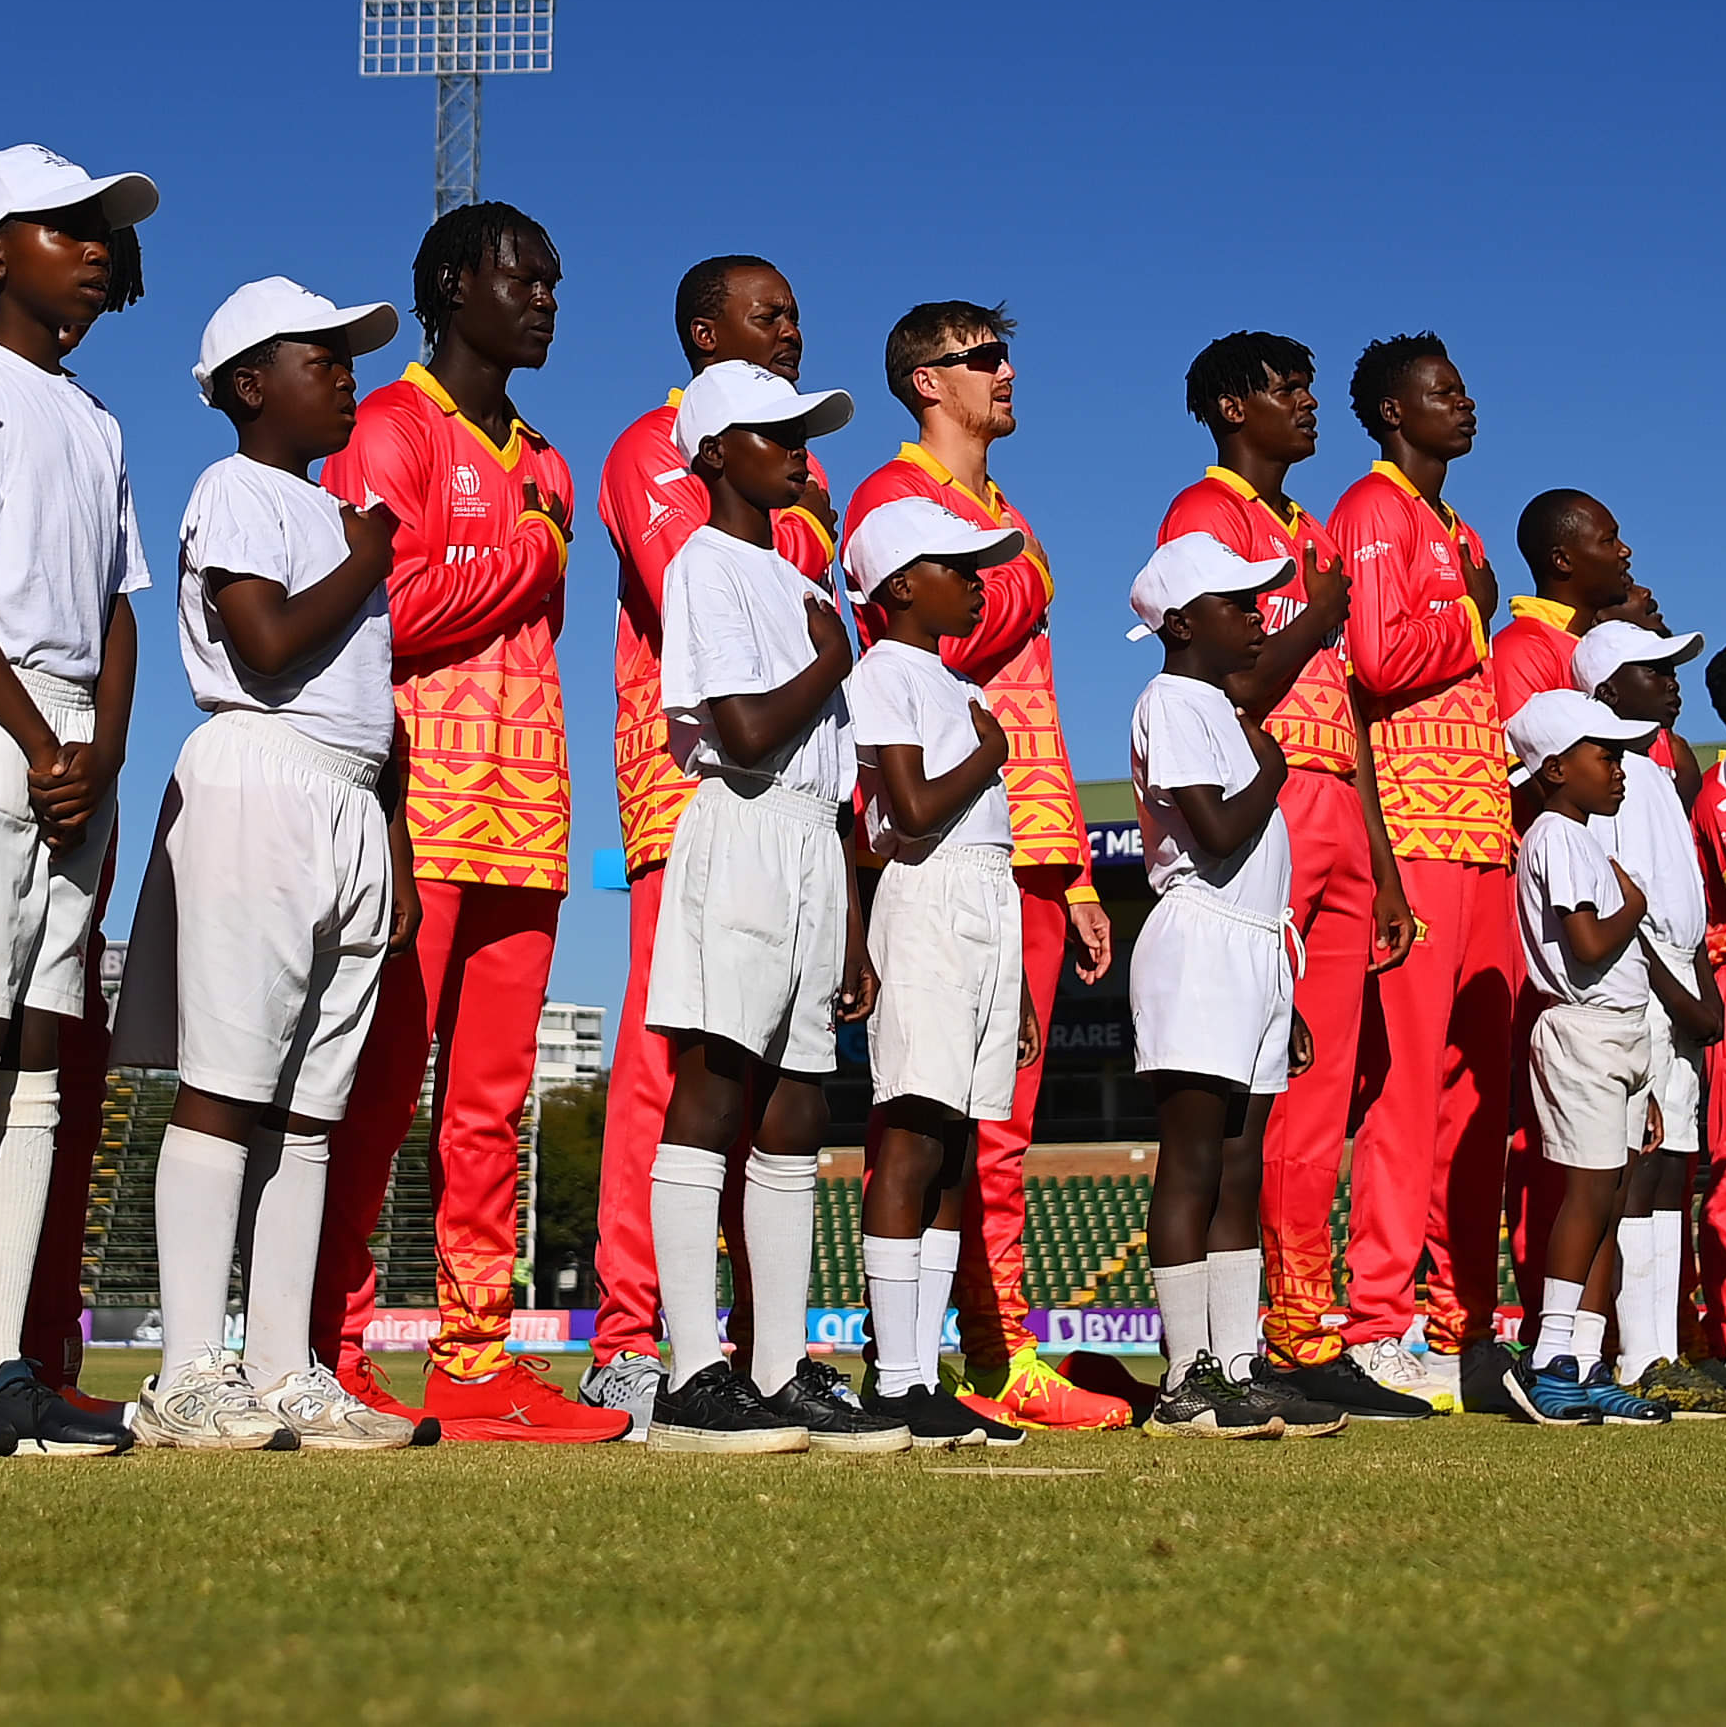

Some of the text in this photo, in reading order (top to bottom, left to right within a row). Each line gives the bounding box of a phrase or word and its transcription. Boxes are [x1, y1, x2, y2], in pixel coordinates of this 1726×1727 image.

[1087, 829, 1144, 858] C ME
[1047, 1024, 1121, 1048] RARE
[1083, 1312, 1160, 1343] BYJU
